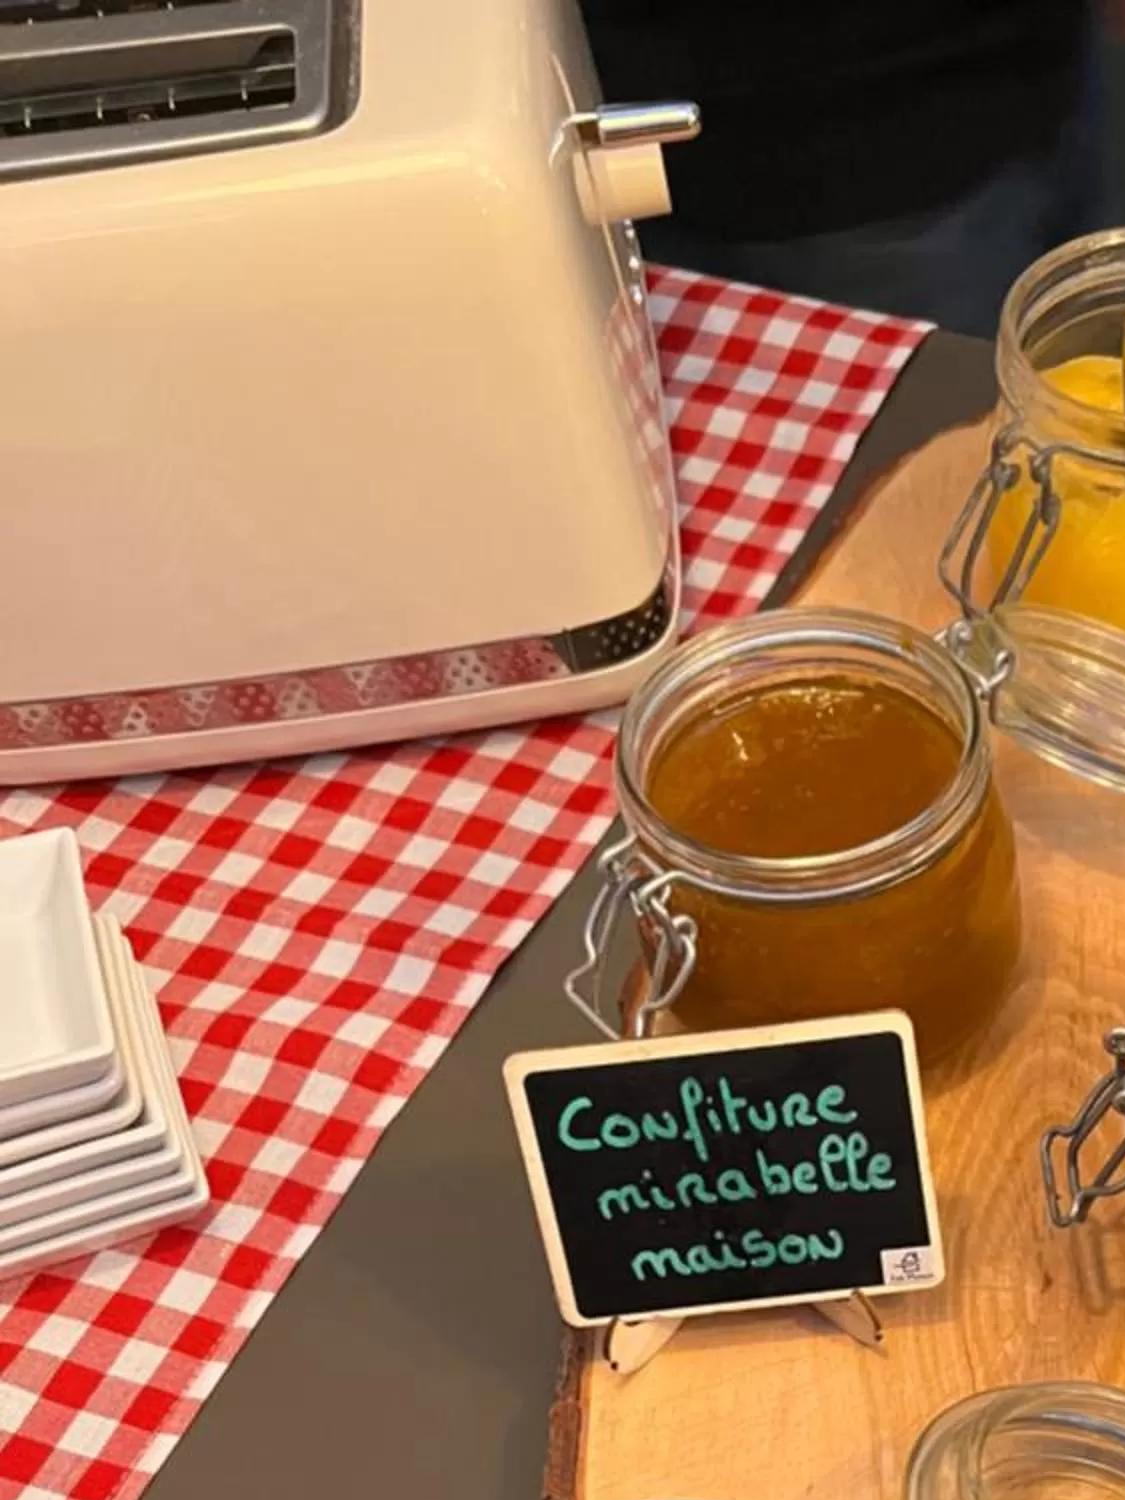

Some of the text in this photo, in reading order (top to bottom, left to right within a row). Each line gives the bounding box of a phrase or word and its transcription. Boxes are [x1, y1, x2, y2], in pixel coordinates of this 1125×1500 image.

[557, 1076, 858, 1161] Confiture
[597, 1131, 897, 1221] mirabelle
[630, 1230, 845, 1282] maison
